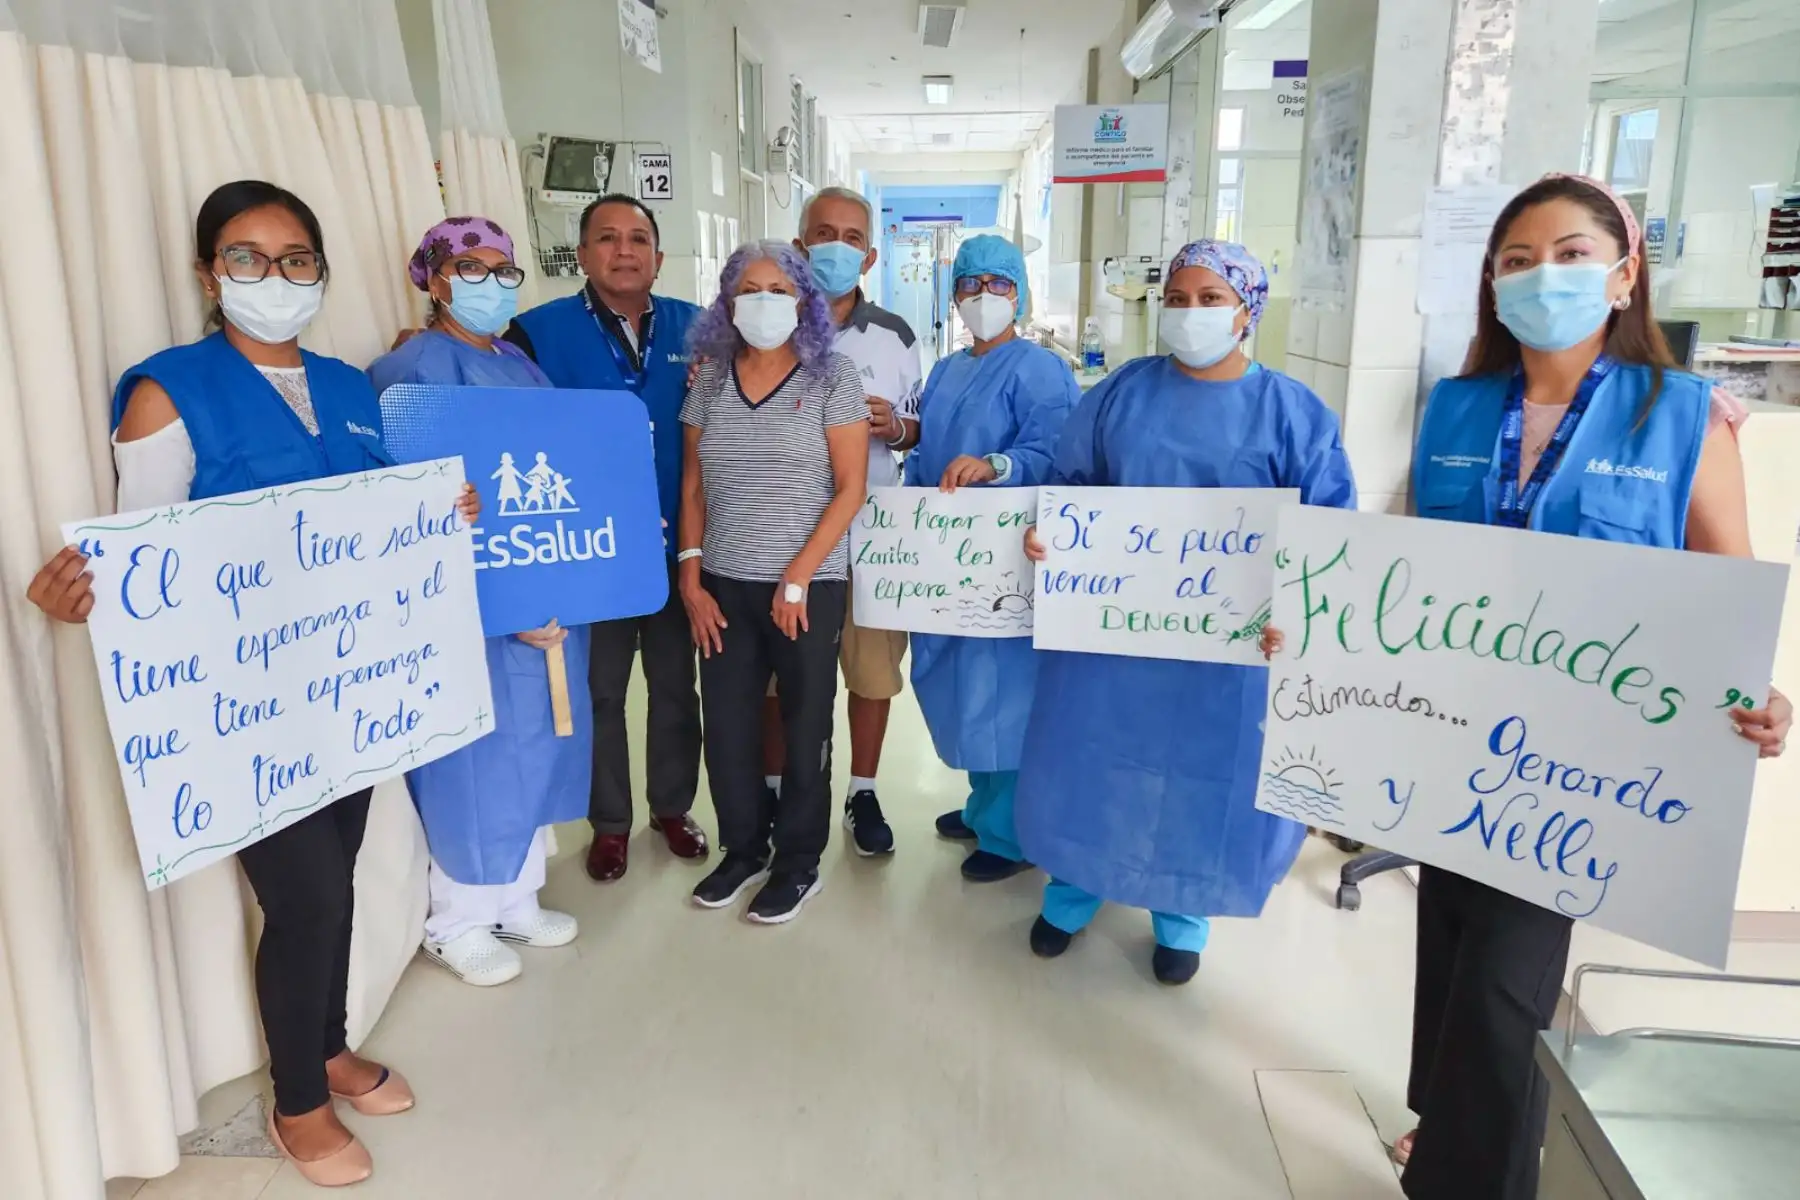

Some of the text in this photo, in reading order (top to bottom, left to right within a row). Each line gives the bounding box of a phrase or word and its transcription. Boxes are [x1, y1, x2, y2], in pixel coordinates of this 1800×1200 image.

[1283, 107, 1305, 117] Ped
[643, 159, 669, 168] CAMA
[645, 174, 669, 192] 12
[861, 495, 1036, 544] Su hogar en
[1124, 524, 1163, 553] se
[1179, 506, 1266, 564] pudo
[216, 560, 272, 621] que
[290, 509, 366, 571] tiene
[378, 500, 463, 557] salud
[955, 538, 993, 566] los
[1042, 566, 1218, 598] vencer al
[110, 560, 447, 703] tiene esperanza y el
[124, 643, 439, 788] que tiene esperanza
[172, 783, 212, 838] lo
[252, 752, 319, 806] tiene
[1372, 778, 1617, 918] y Nelly
